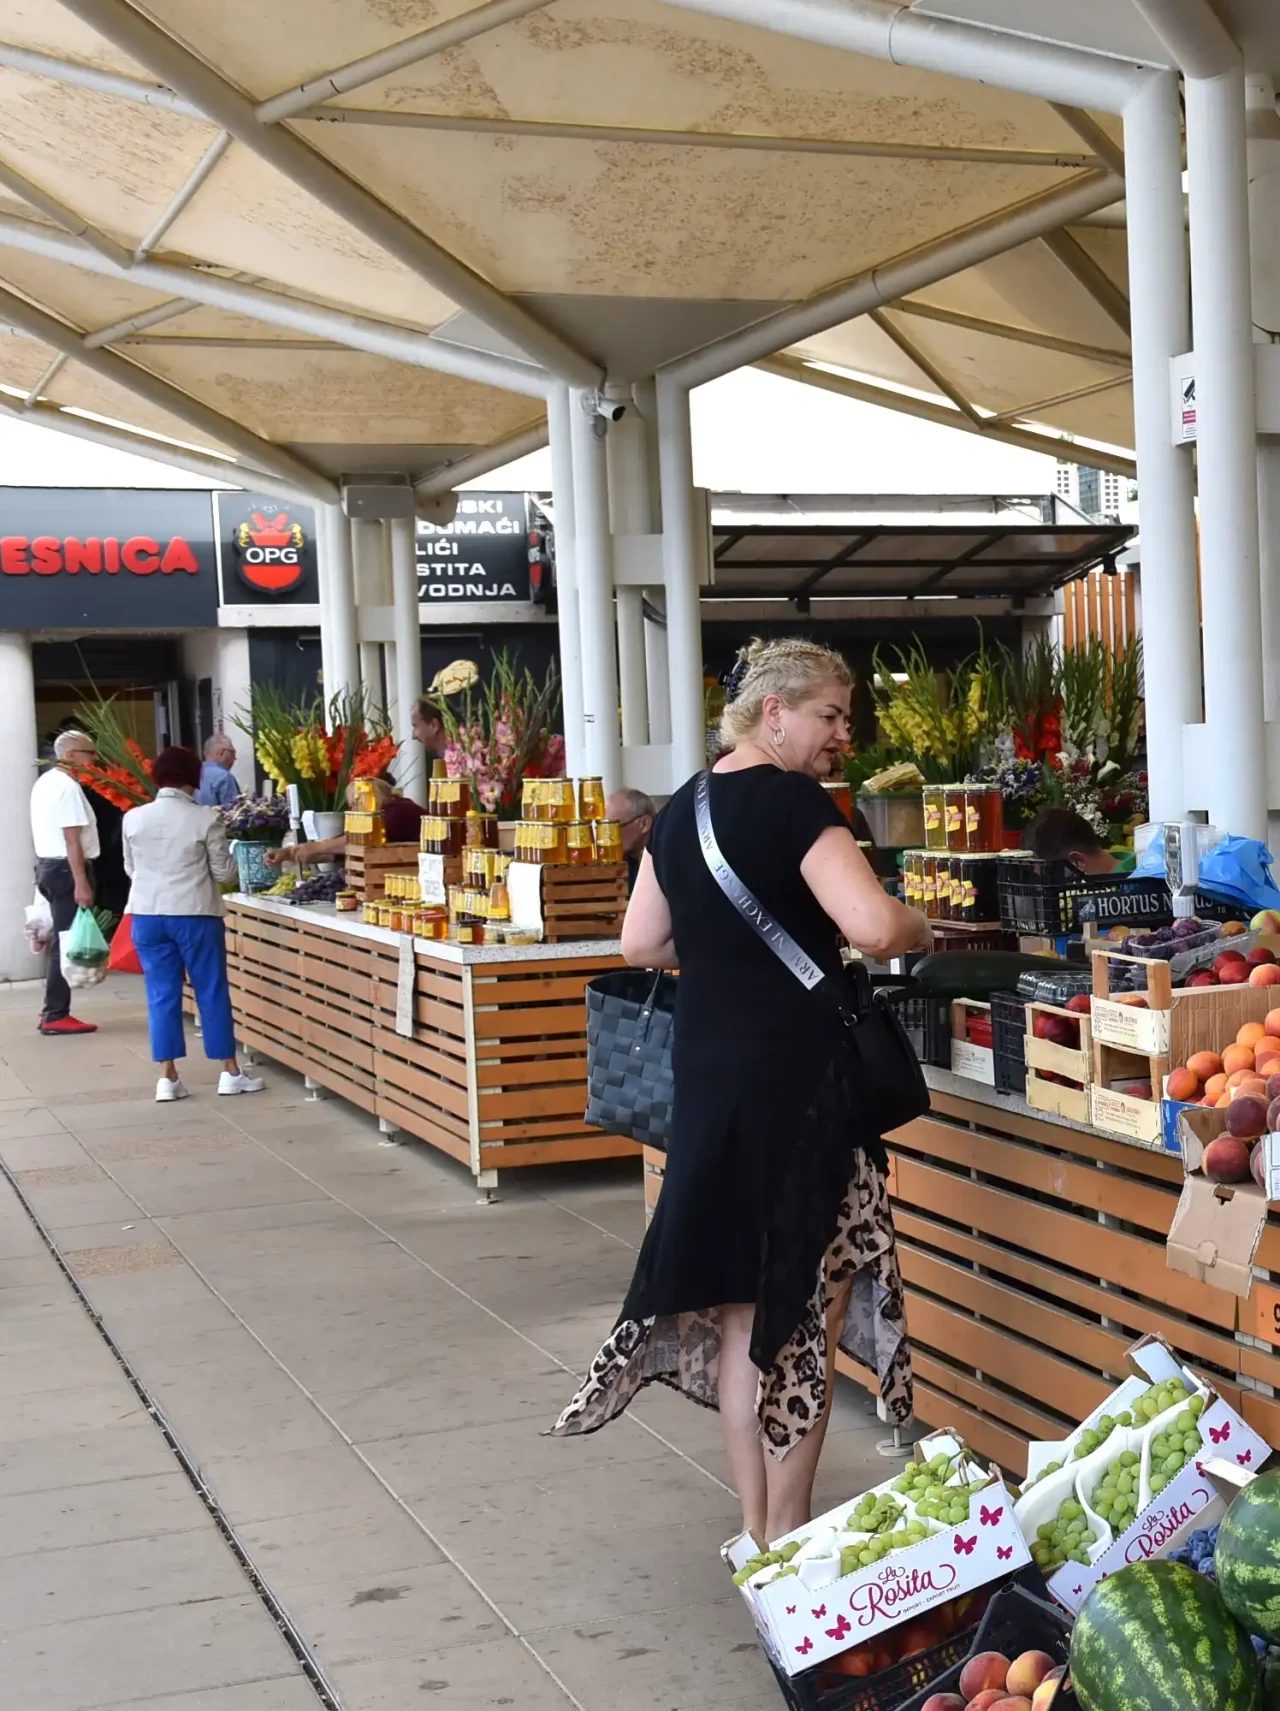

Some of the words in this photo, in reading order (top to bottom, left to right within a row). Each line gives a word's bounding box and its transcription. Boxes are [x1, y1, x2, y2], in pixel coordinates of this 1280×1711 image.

[456, 500, 503, 514] SKI
[0, 536, 198, 576] ESNICA
[245, 547, 298, 564] OPG
[1097, 893, 1160, 918] HORTUS
[1124, 1488, 1210, 1564] Rosita
[849, 1563, 957, 1627] Rosita
